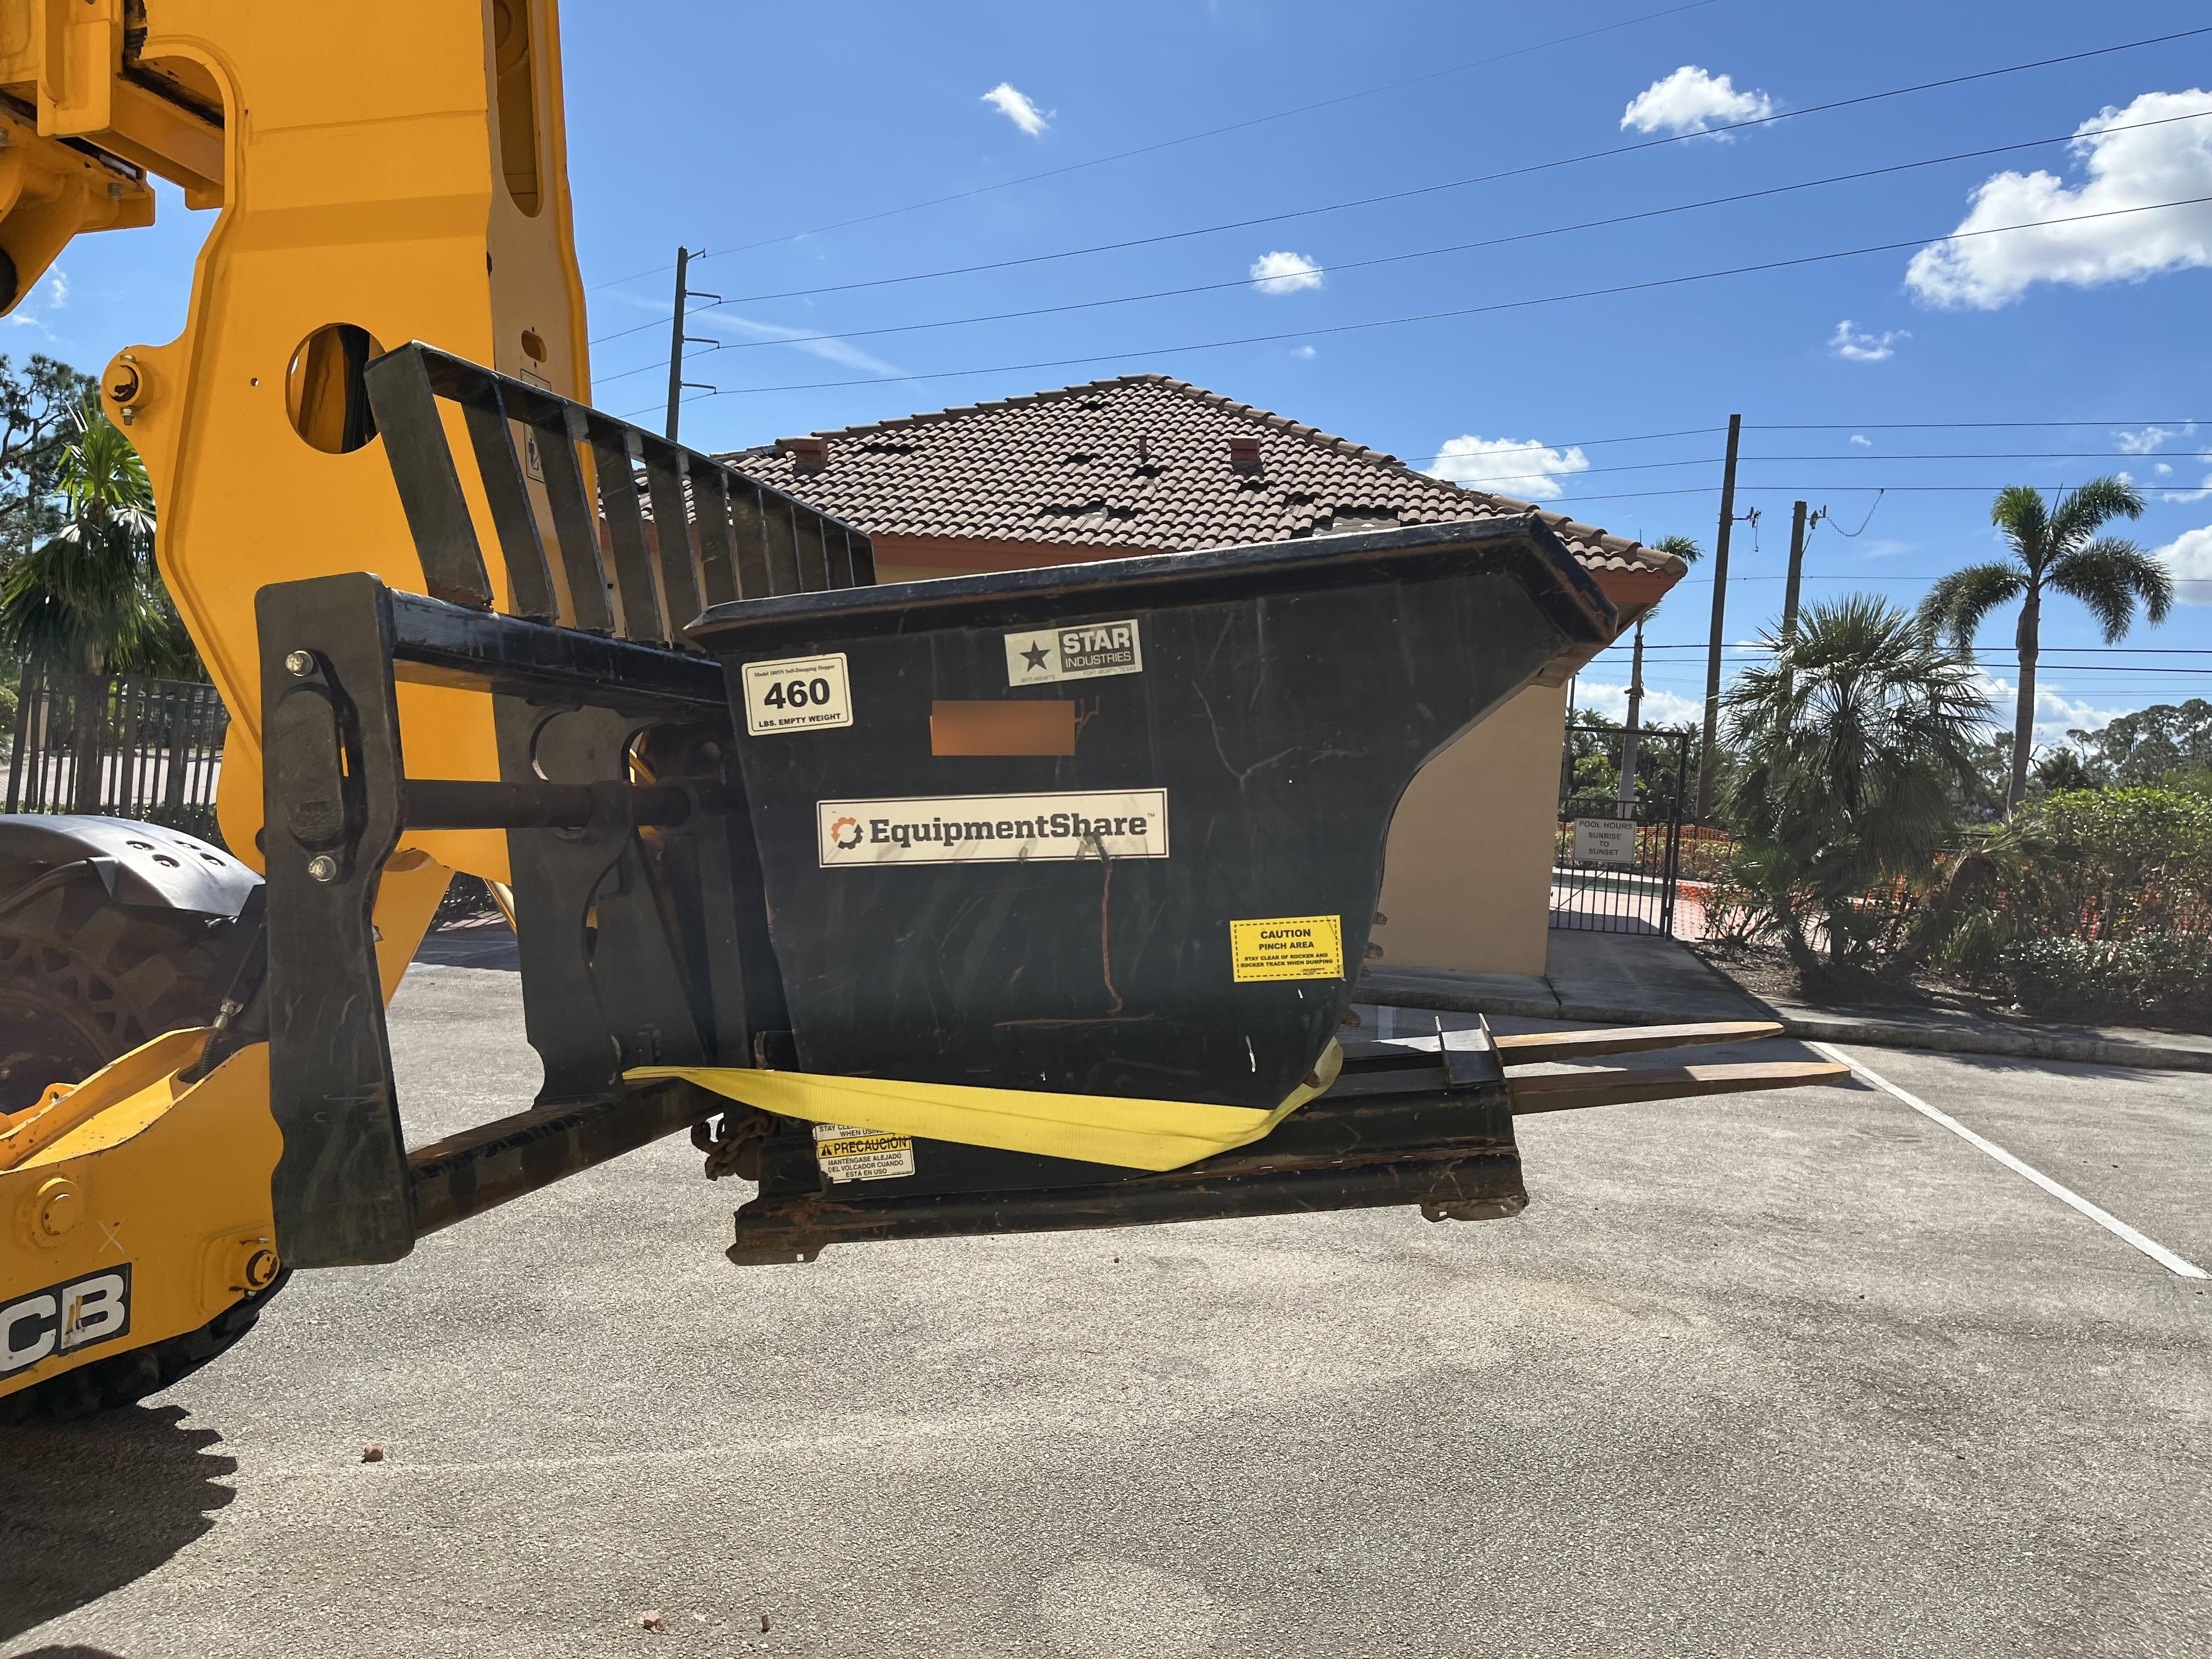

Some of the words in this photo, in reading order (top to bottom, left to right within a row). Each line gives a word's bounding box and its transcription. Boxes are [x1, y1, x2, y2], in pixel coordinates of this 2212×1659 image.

[1063, 627, 1131, 654] STAR
[1065, 651, 1131, 668] INDUSTRIES
[764, 678, 830, 709] 460
[779, 717, 806, 725] EMPTY
[808, 713, 841, 723] WEIGHT
[870, 813, 1147, 847] EquipmentShare
[1261, 929, 1311, 939] CAUTION
[828, 1156, 871, 1165] MANTÉNGASE
[841, 1163, 876, 1171] VOLCADOR
[846, 1169, 862, 1178] ESTÁ
